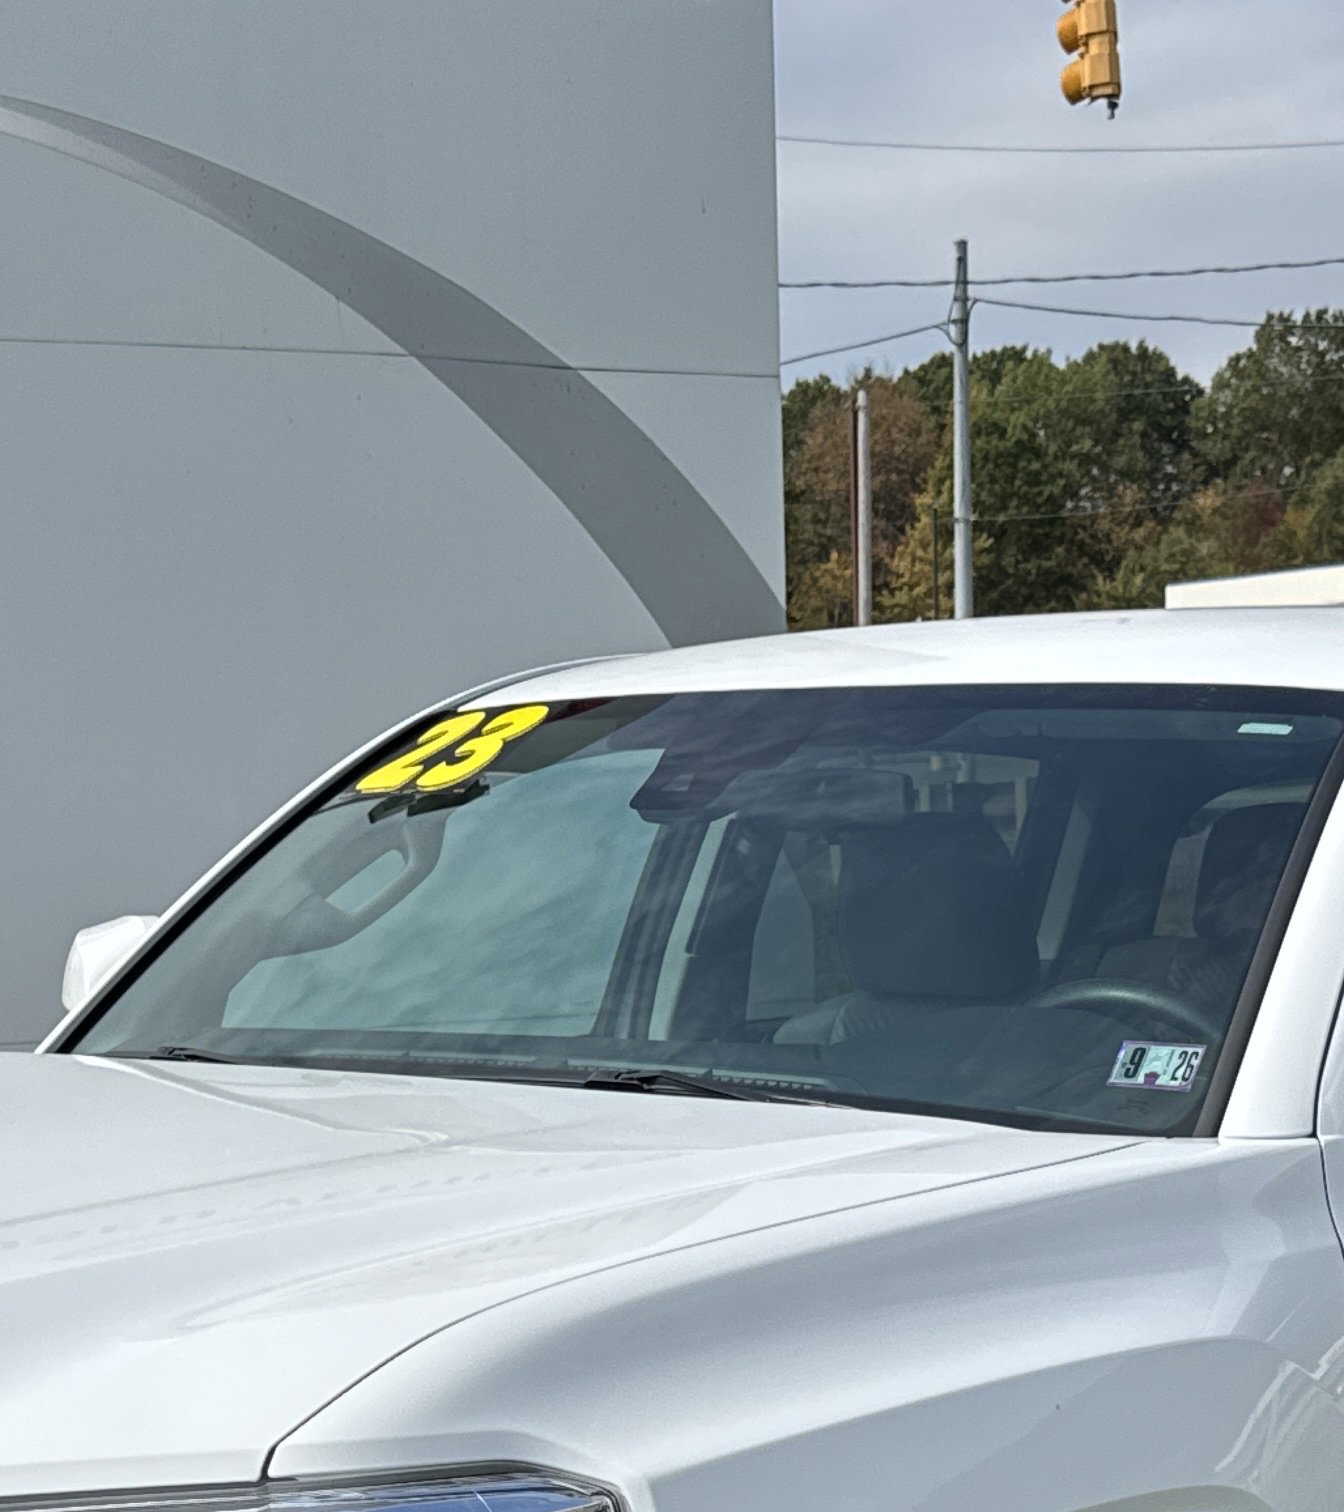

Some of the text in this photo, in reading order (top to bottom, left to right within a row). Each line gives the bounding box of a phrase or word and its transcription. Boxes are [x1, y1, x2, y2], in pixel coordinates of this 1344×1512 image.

[356, 705, 549, 793] 23
[1124, 1047, 1147, 1078] 9
[1170, 1050, 1199, 1082] 26
